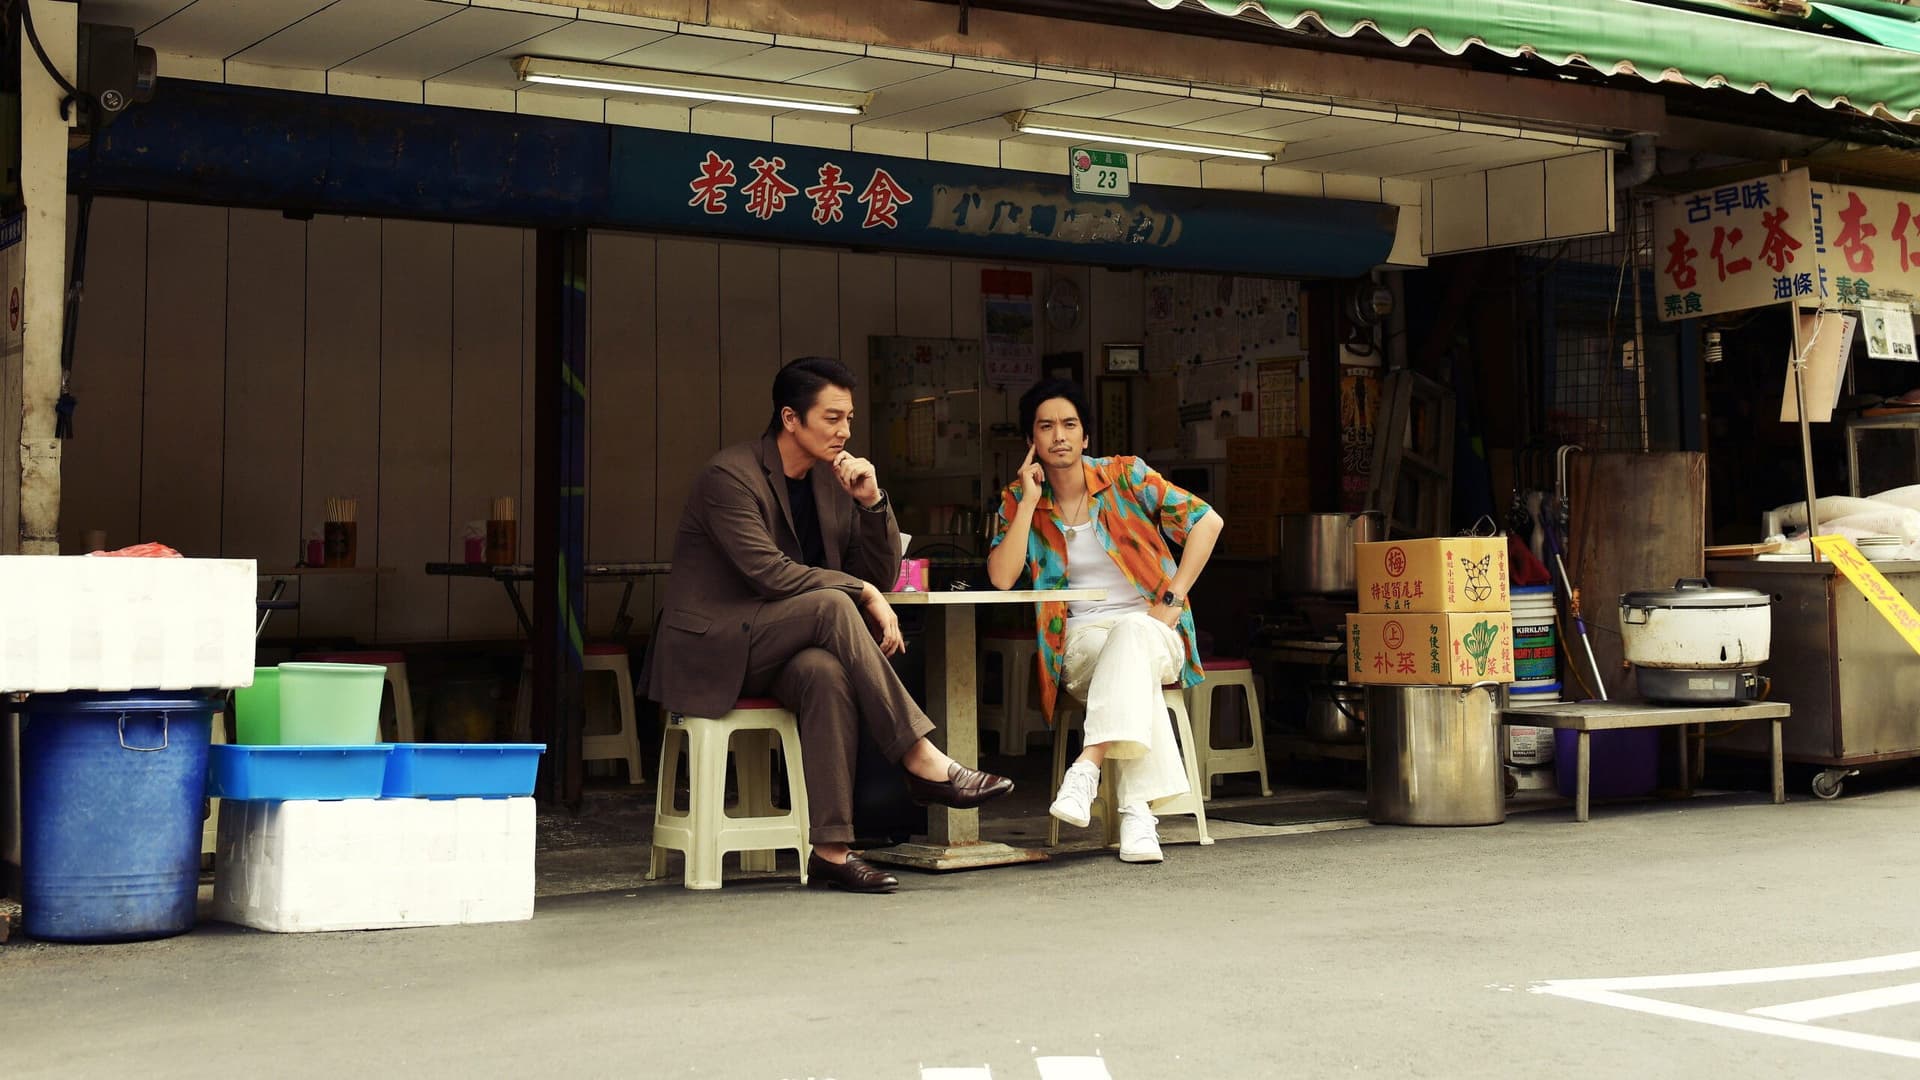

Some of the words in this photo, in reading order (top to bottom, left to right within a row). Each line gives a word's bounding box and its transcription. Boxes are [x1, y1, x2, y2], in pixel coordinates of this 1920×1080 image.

[689, 150, 912, 229] 老爺素食
[1097, 170, 1118, 189] 23
[1685, 180, 1770, 224] 古早味
[1664, 207, 1802, 290] 杏仁茶
[1772, 273, 1813, 300] 油條
[1664, 292, 1703, 317] 素食
[1388, 551, 1404, 573] 梅
[1388, 628, 1400, 641] 上
[1516, 626, 1549, 634] KIRKLAND
[1374, 652, 1416, 675] 朴菜
